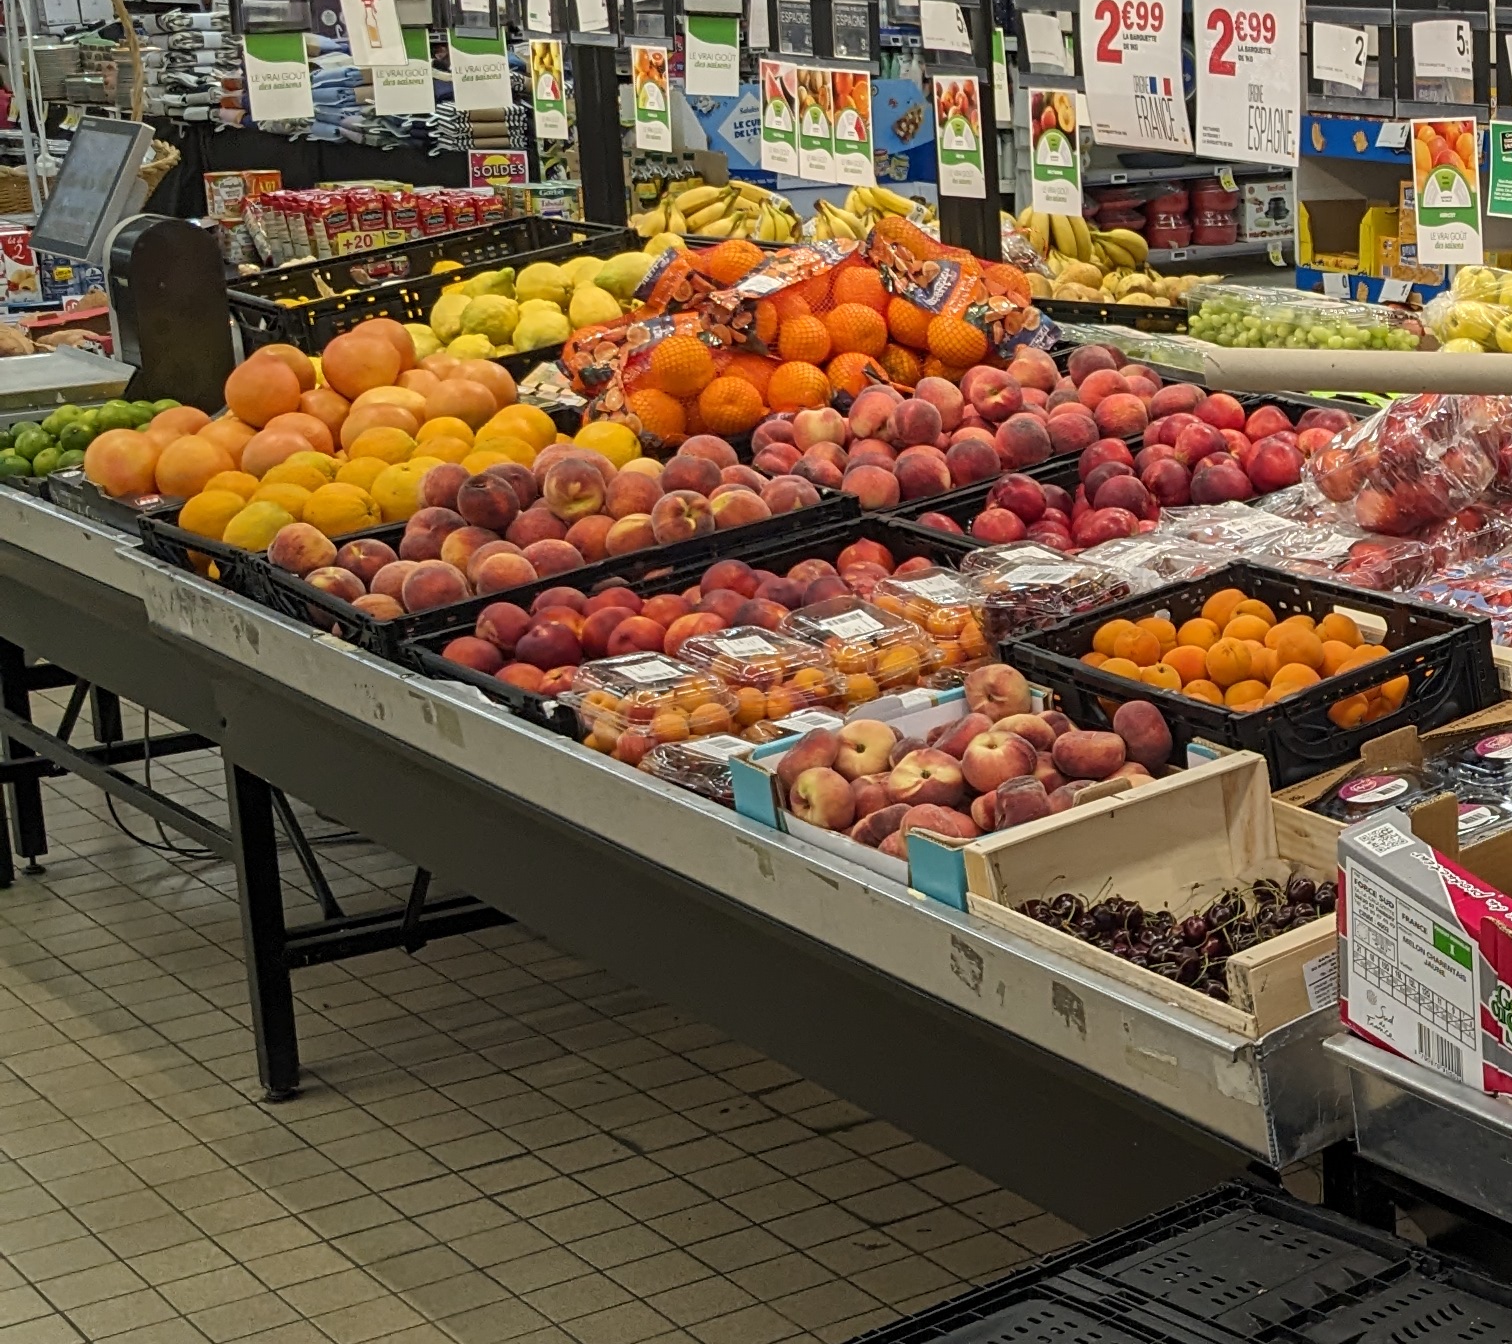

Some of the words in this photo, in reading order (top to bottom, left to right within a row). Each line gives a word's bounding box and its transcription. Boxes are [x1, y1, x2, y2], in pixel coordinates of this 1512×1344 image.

[781, 11, 809, 24] ESPAGNE
[836, 14, 866, 27] ESPAGNE
[956, 9, 965, 34] 5
[1354, 35, 1365, 67] 2
[1456, 25, 1466, 56] 5
[733, 121, 744, 130] LE
[1134, 94, 1179, 142] FRANCE
[734, 130, 746, 139] DE
[1247, 105, 1293, 156] ESPAGNE
[473, 164, 525, 178] SOLDES
[342, 234, 374, 249] +20
[1354, 878, 1377, 898] FORCE
[1379, 893, 1395, 909] SUD
[1401, 912, 1428, 935] FRANCE
[1402, 936, 1426, 955] MELON
[1426, 950, 1467, 983] CHARENTAIS
